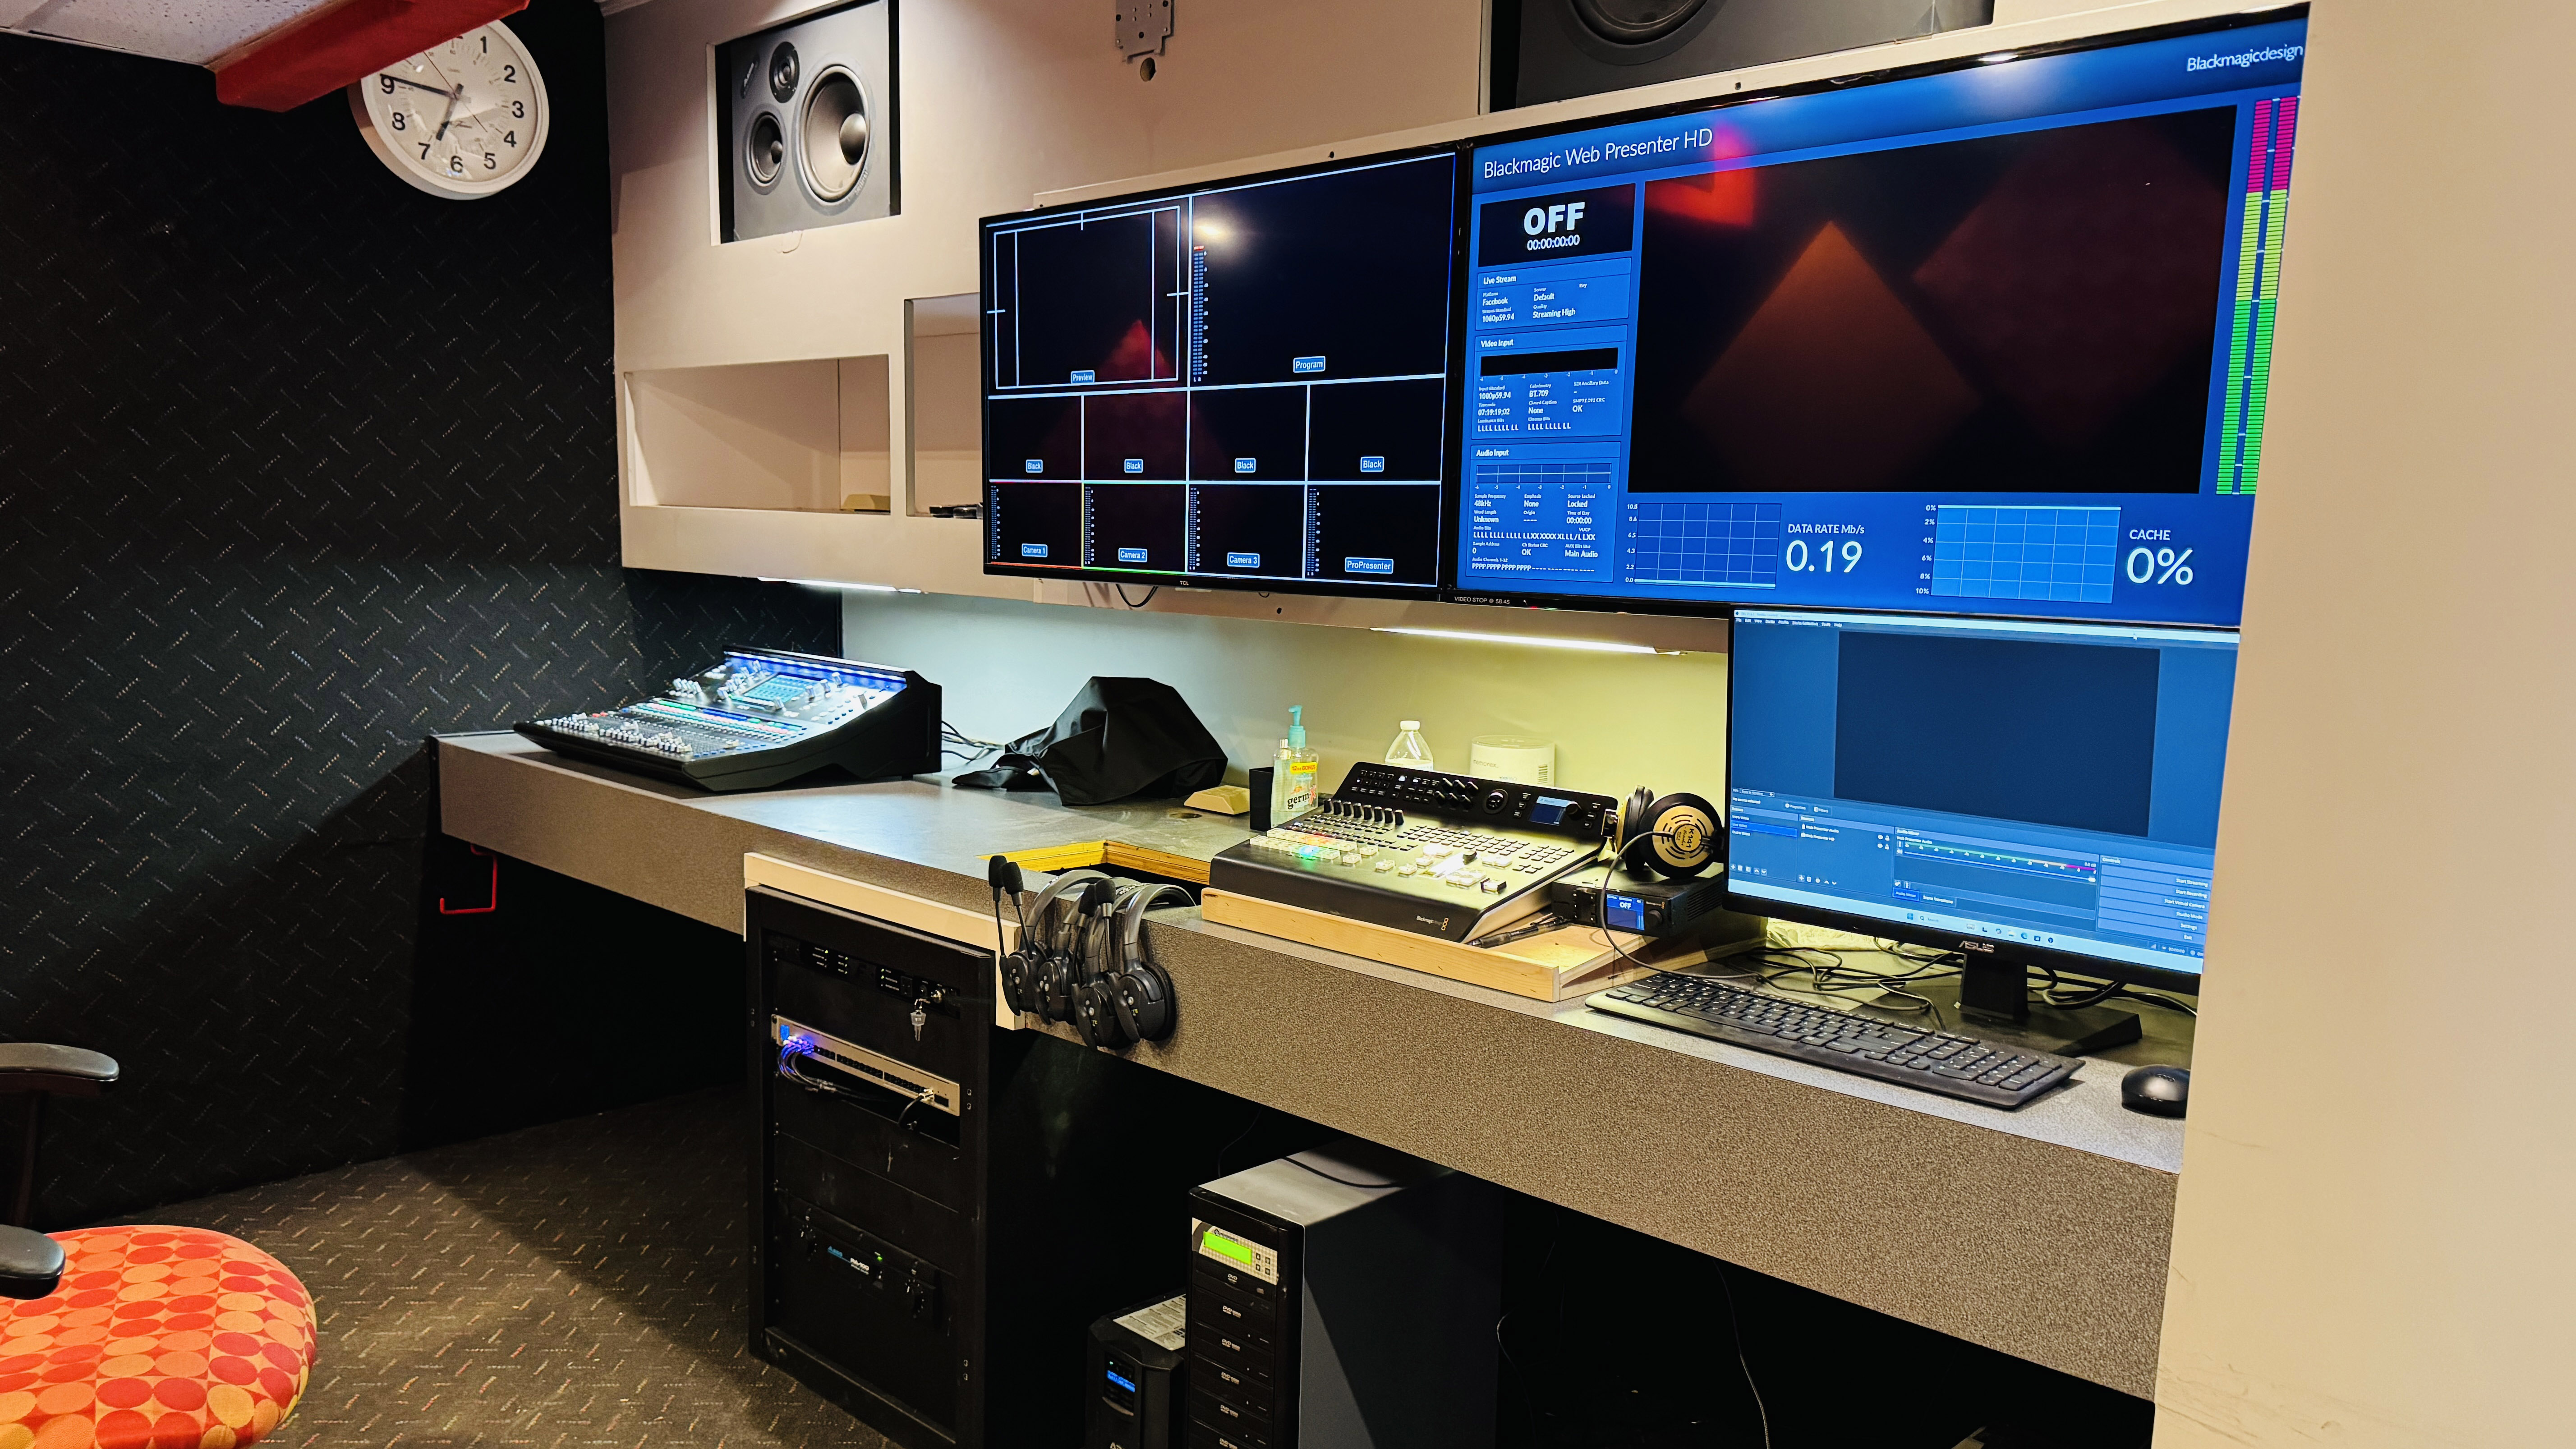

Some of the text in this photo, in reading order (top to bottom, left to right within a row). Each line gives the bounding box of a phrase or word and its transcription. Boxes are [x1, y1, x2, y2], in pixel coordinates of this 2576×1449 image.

[480, 36, 487, 53] 1
[2187, 44, 2303, 71] Blackmagicdesign
[504, 65, 515, 83] 2
[512, 101, 524, 118] 3
[392, 112, 405, 130] 8
[503, 131, 517, 147] 4
[418, 142, 430, 160] 7
[1484, 128, 1712, 178] Blackmagic Web Presenter HD
[451, 156, 463, 173] 6
[483, 152, 496, 170] 5
[1524, 202, 1585, 235] OFF
[1527, 235, 1580, 251] 00:00:00:00
[1482, 297, 1508, 306] Facebook
[1533, 293, 1555, 301] Default
[1533, 308, 1576, 318] Streaming High
[1296, 360, 1323, 370] Program
[1494, 449, 1509, 457] Input
[1126, 462, 1141, 470] Black
[1237, 461, 1253, 470] Black
[1363, 460, 1381, 469] Black
[1788, 524, 1865, 534] DATA RATE Mb/s
[2129, 529, 2171, 541] CACHE
[1120, 550, 1140, 559] Camera
[1229, 555, 1250, 564] Camera
[1785, 539, 1863, 574] 0.19
[1347, 561, 1391, 571] ProPresenter
[2126, 547, 2193, 585] 0%
